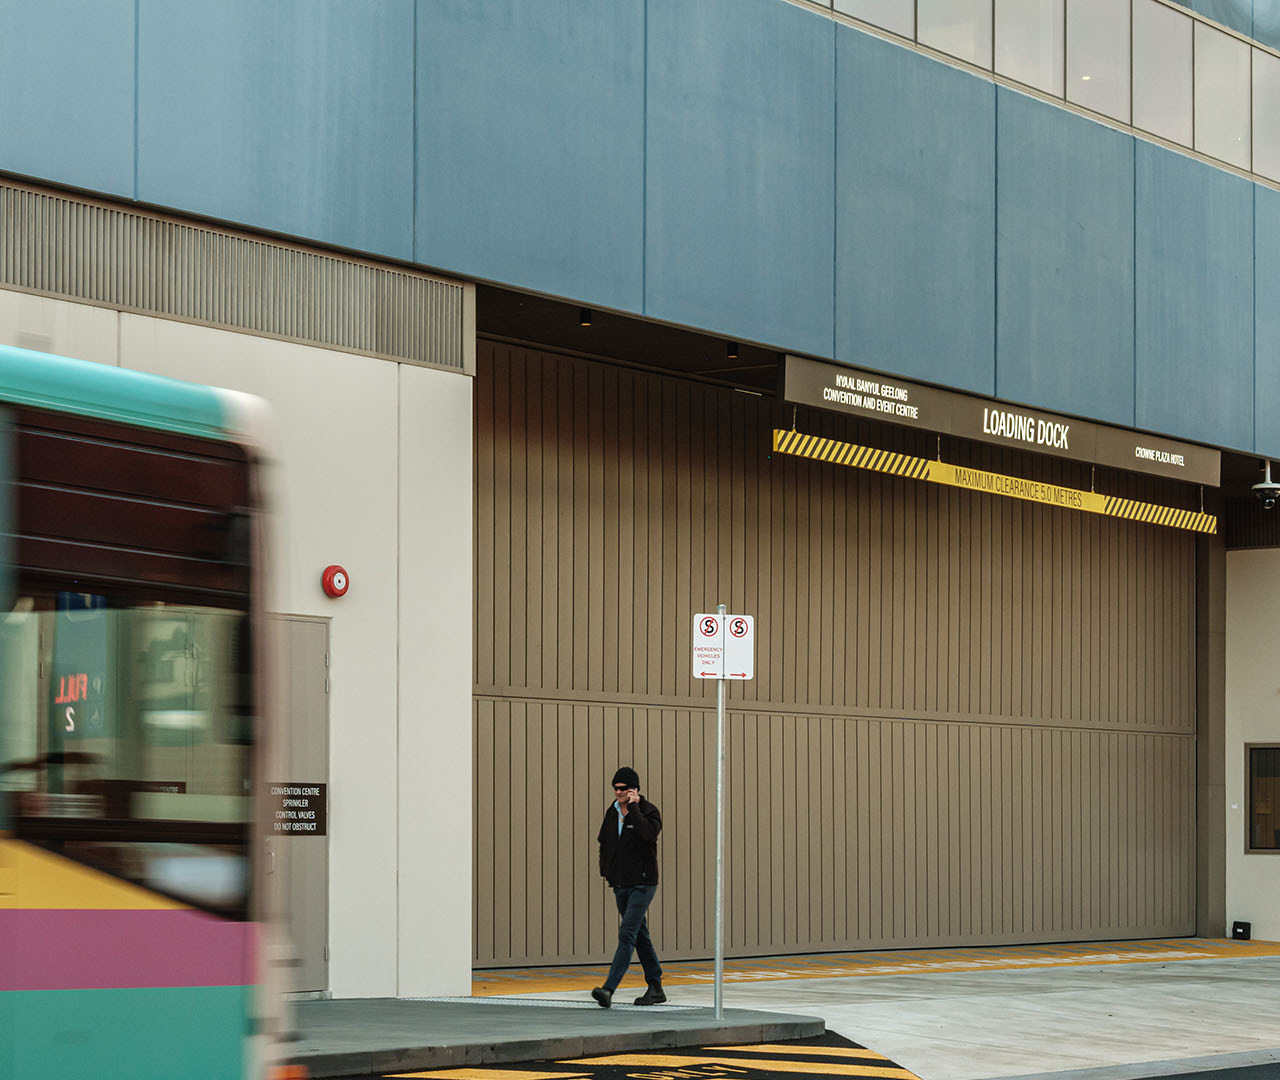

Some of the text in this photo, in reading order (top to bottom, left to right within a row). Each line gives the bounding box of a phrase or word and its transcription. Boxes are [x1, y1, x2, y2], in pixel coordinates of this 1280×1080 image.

[835, 374, 908, 402] NYAAL BANYUL GEELONG
[823, 387, 919, 420] CONVENTION AND EVENT CENTRE
[983, 407, 1070, 450] LOADING DOCK
[1135, 446, 1185, 467] CROWNE PLAZA HOTEL
[954, 467, 1083, 508] MAXIMUM CLEARANCE 5.0 METRES
[270, 787, 320, 796] CONVENTION CENTRE
[282, 798, 309, 807] SPRINKLER
[275, 811, 316, 819] CONTROL VALVES
[273, 822, 317, 831] DO NOT OBSTRUCT
[625, 1065, 749, 1080] ONLY
